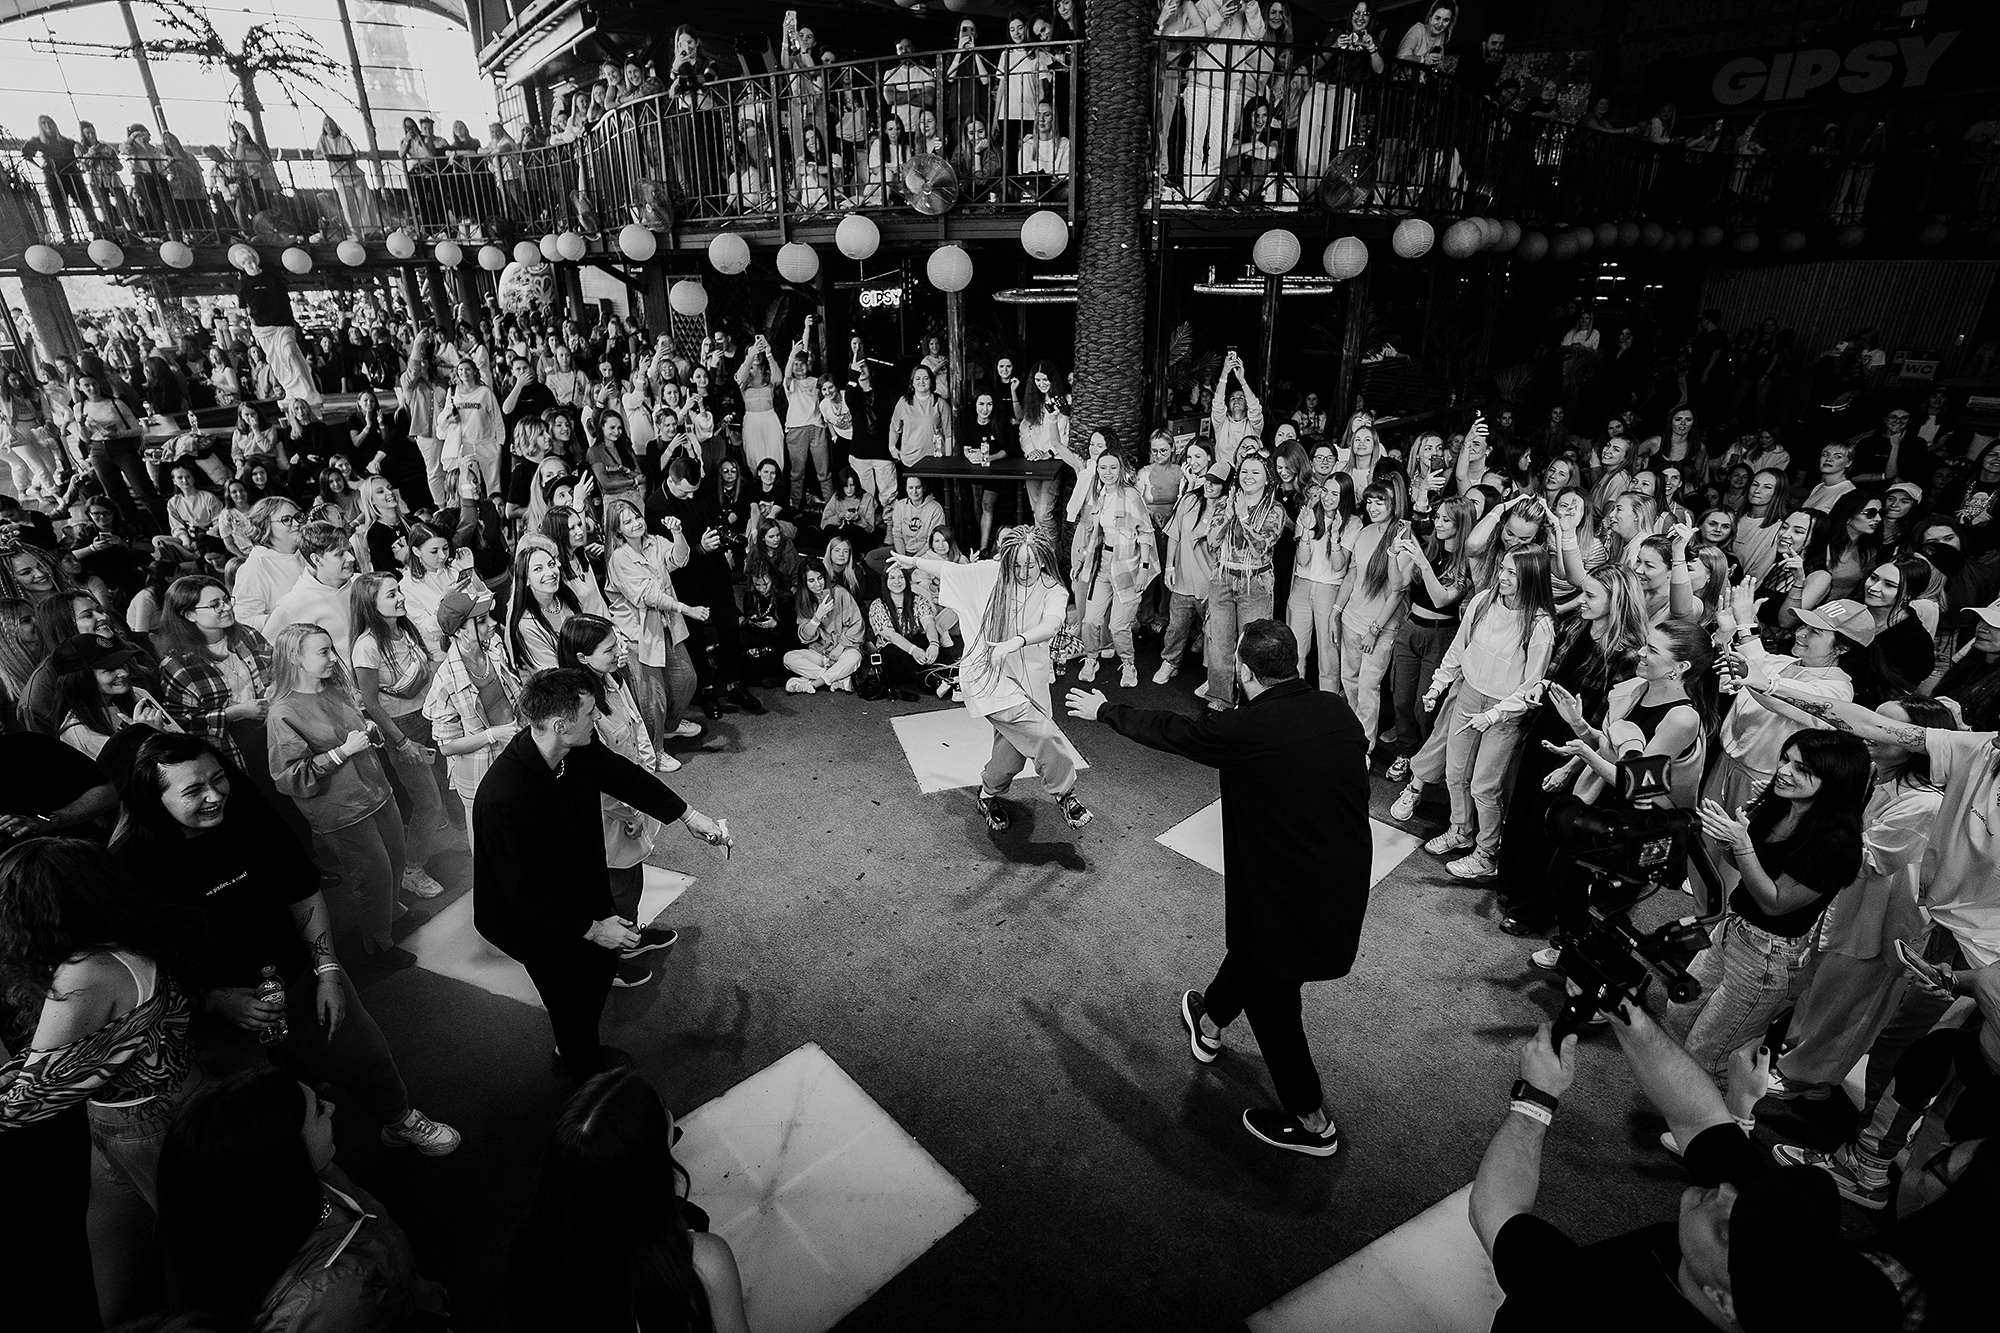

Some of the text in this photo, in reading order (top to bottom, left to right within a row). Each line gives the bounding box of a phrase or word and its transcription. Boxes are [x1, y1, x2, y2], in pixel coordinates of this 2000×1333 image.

[1712, 29, 1963, 105] GIPSY
[859, 288, 902, 308] GIPSY
[1906, 364, 1933, 375] WC
